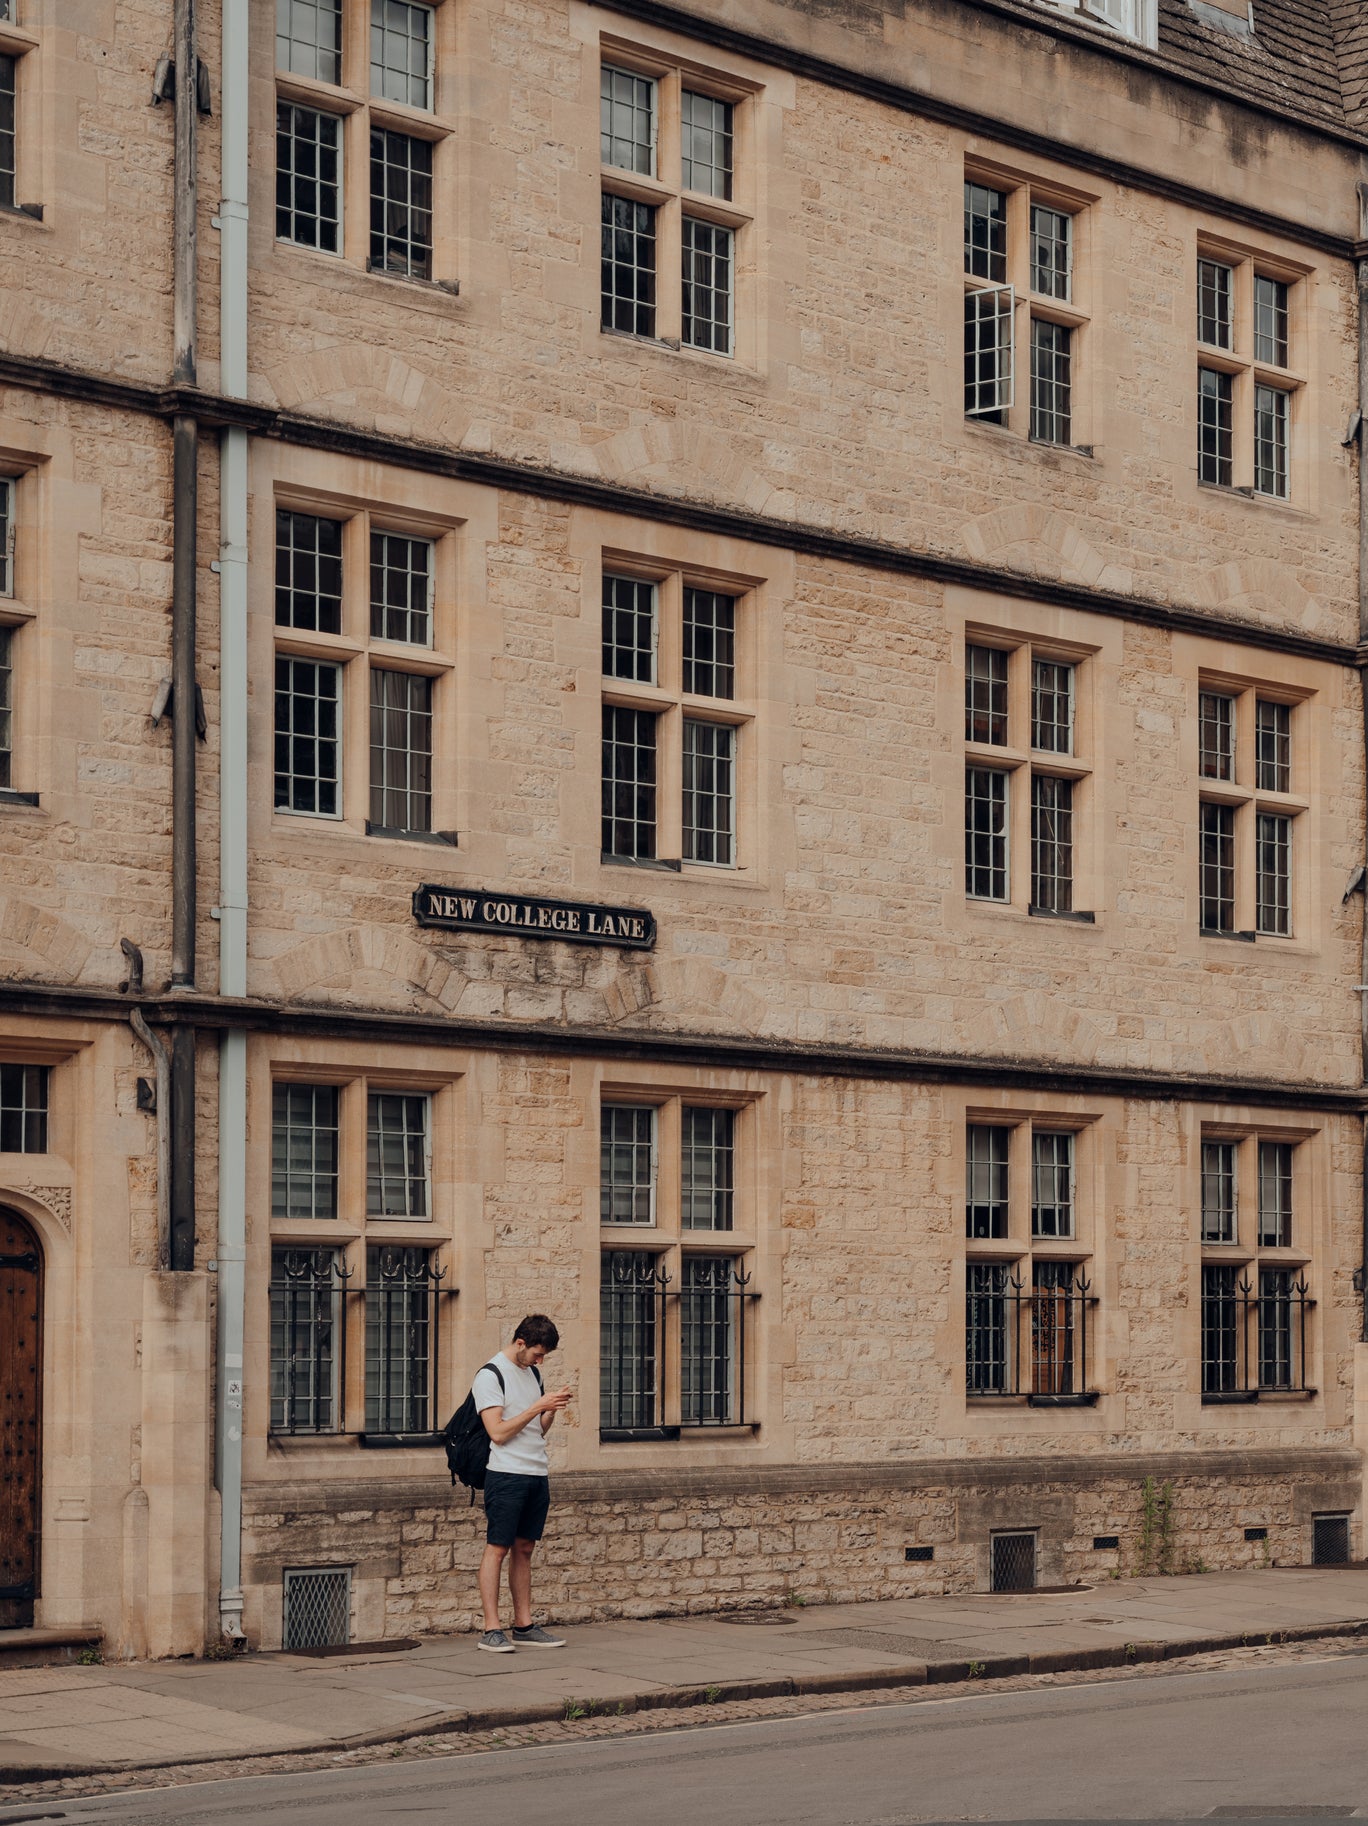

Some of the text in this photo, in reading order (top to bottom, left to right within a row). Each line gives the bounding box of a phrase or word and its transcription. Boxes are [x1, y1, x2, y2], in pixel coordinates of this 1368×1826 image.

[428, 894, 645, 938] NEW COLLEGE LANE
